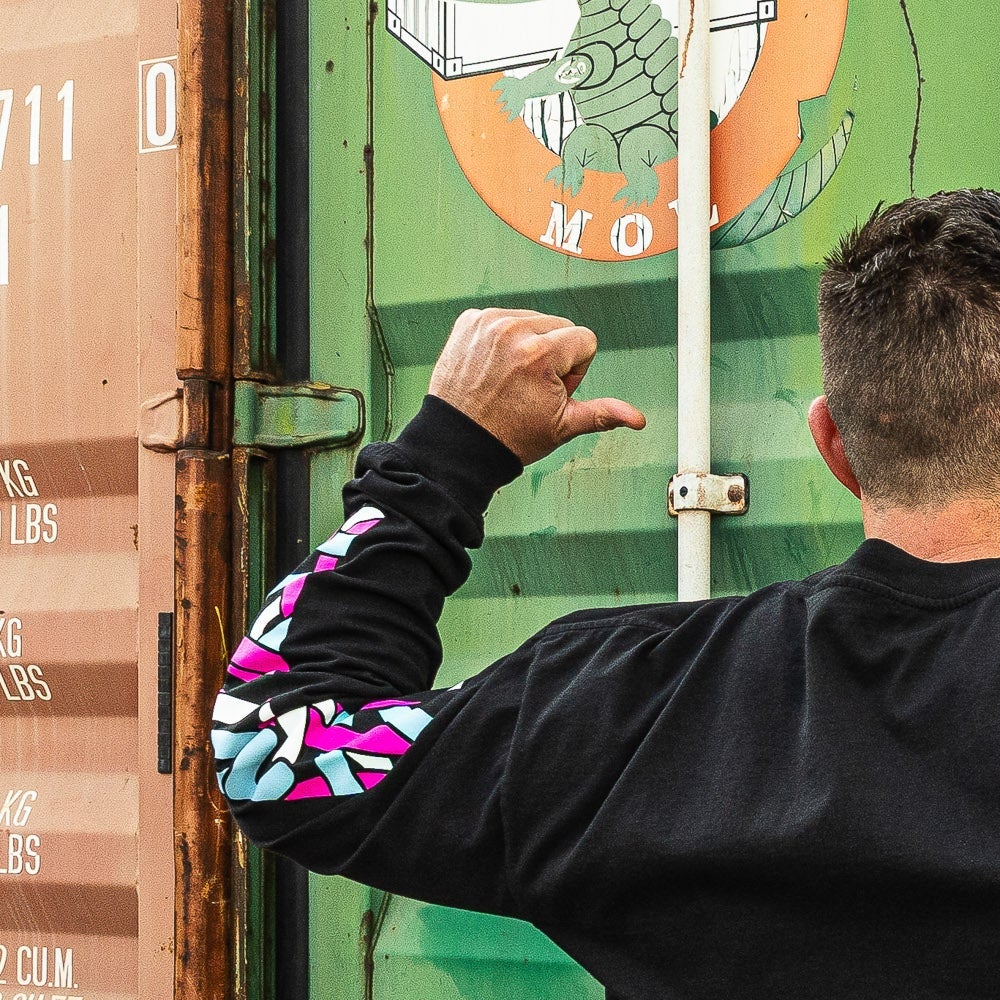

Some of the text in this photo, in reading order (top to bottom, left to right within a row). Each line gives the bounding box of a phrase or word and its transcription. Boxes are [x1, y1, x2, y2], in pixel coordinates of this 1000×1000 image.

[0, 459, 39, 498] KG
[10, 503, 58, 545] LBS
[0, 664, 52, 701] LBS
[0, 789, 38, 827] KG
